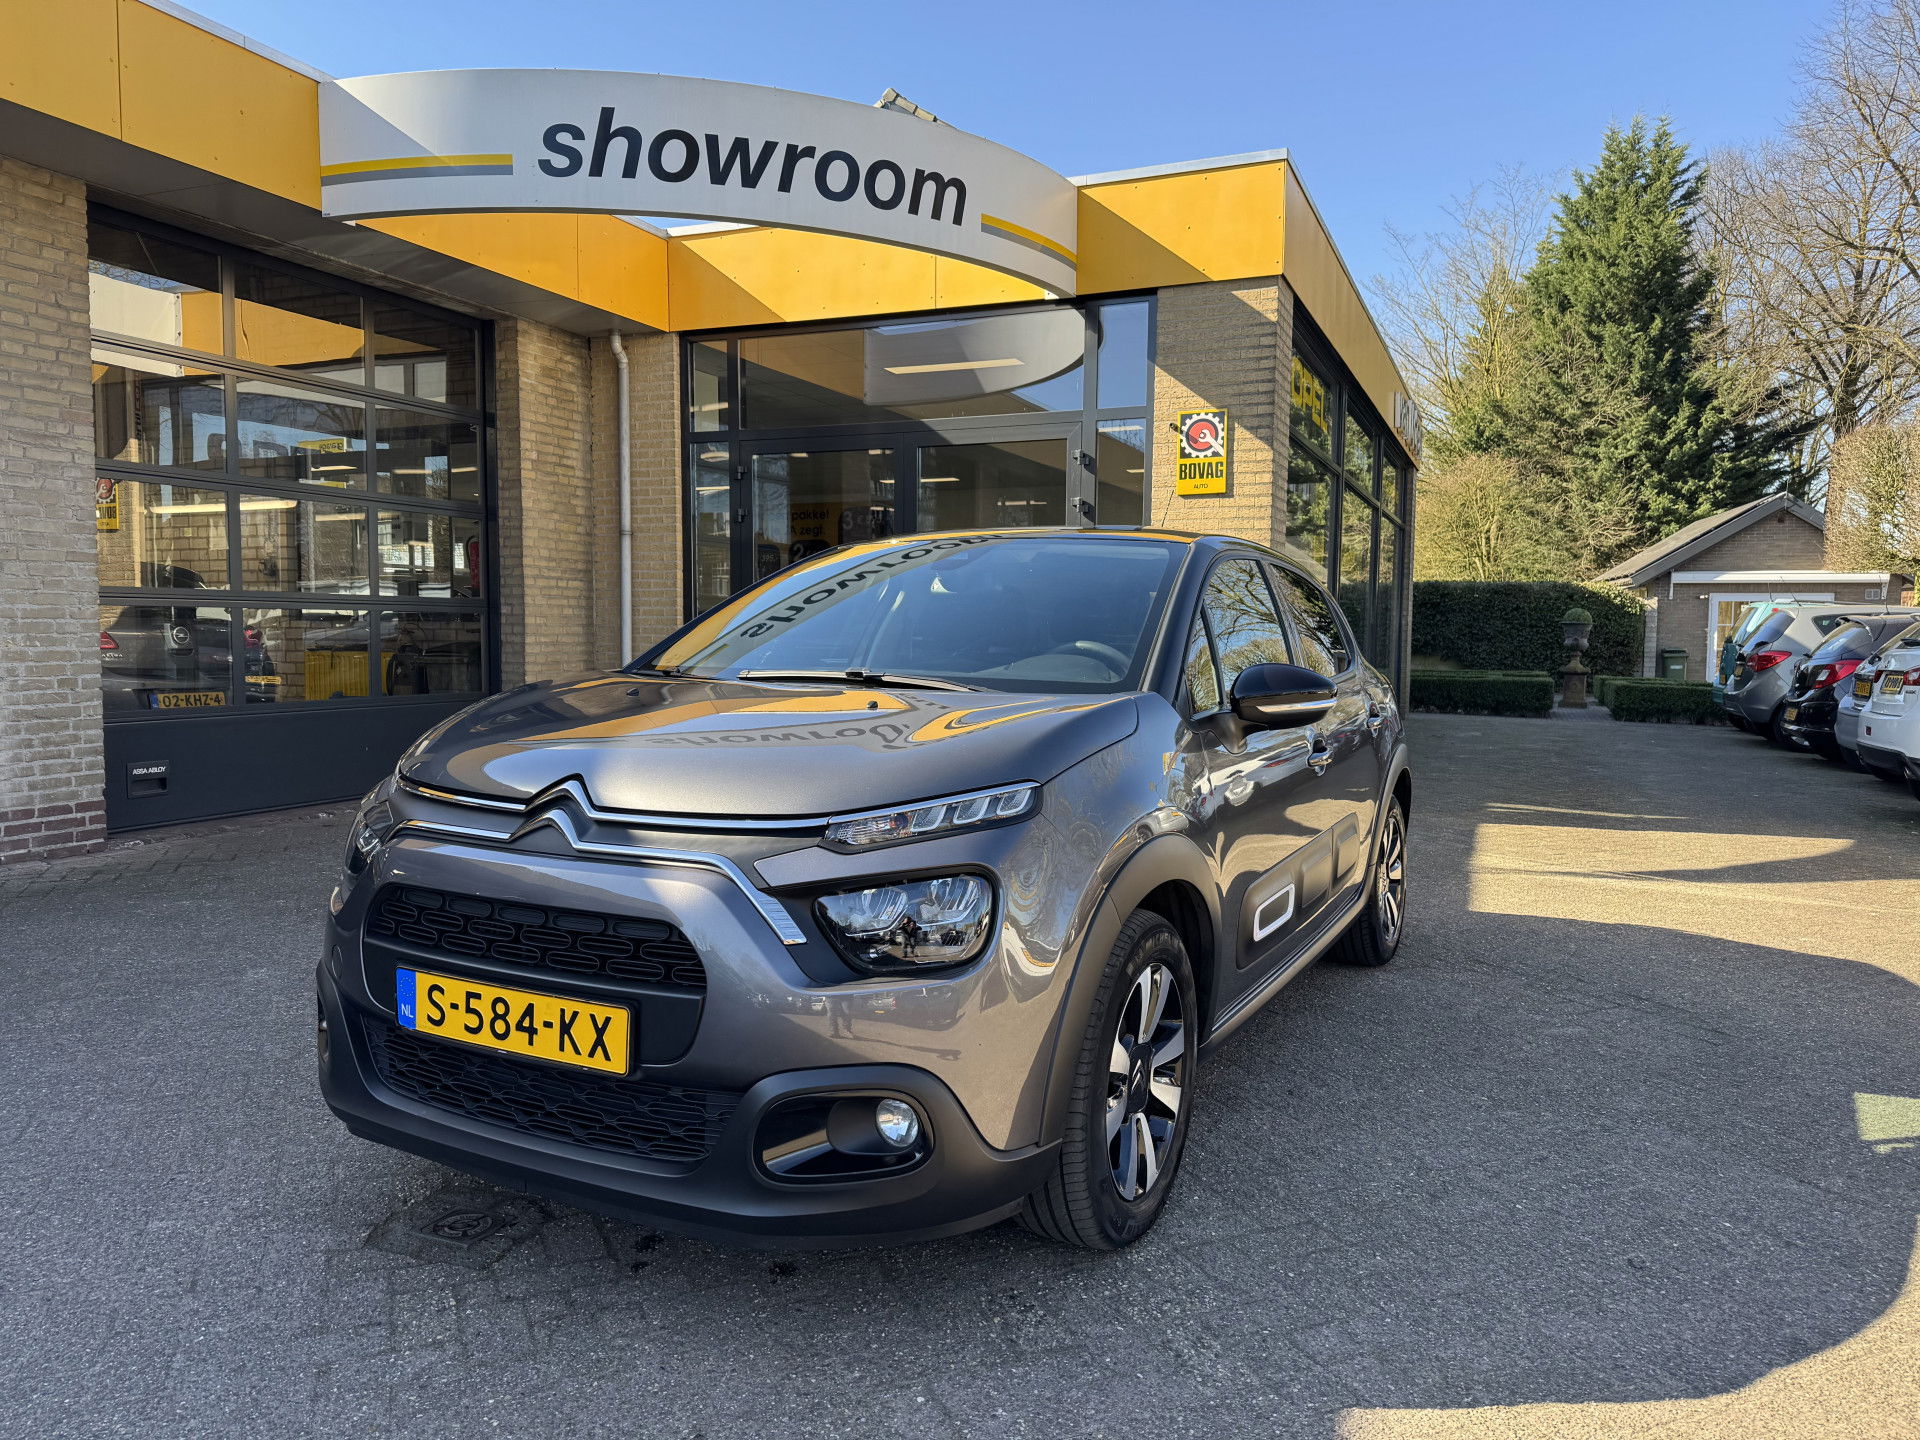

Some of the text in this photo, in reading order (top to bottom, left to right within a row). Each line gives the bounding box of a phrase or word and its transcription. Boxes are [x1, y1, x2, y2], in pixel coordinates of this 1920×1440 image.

[537, 106, 968, 227] showroom
[1291, 356, 1329, 434] OPEL
[1179, 461, 1224, 480] BOVAG
[791, 509, 830, 522] pakket
[162, 693, 222, 708] 02-KHZ-4
[148, 766, 166, 774] ABLOY
[401, 1003, 414, 1018] NL
[426, 983, 612, 1062] S-584-KX
